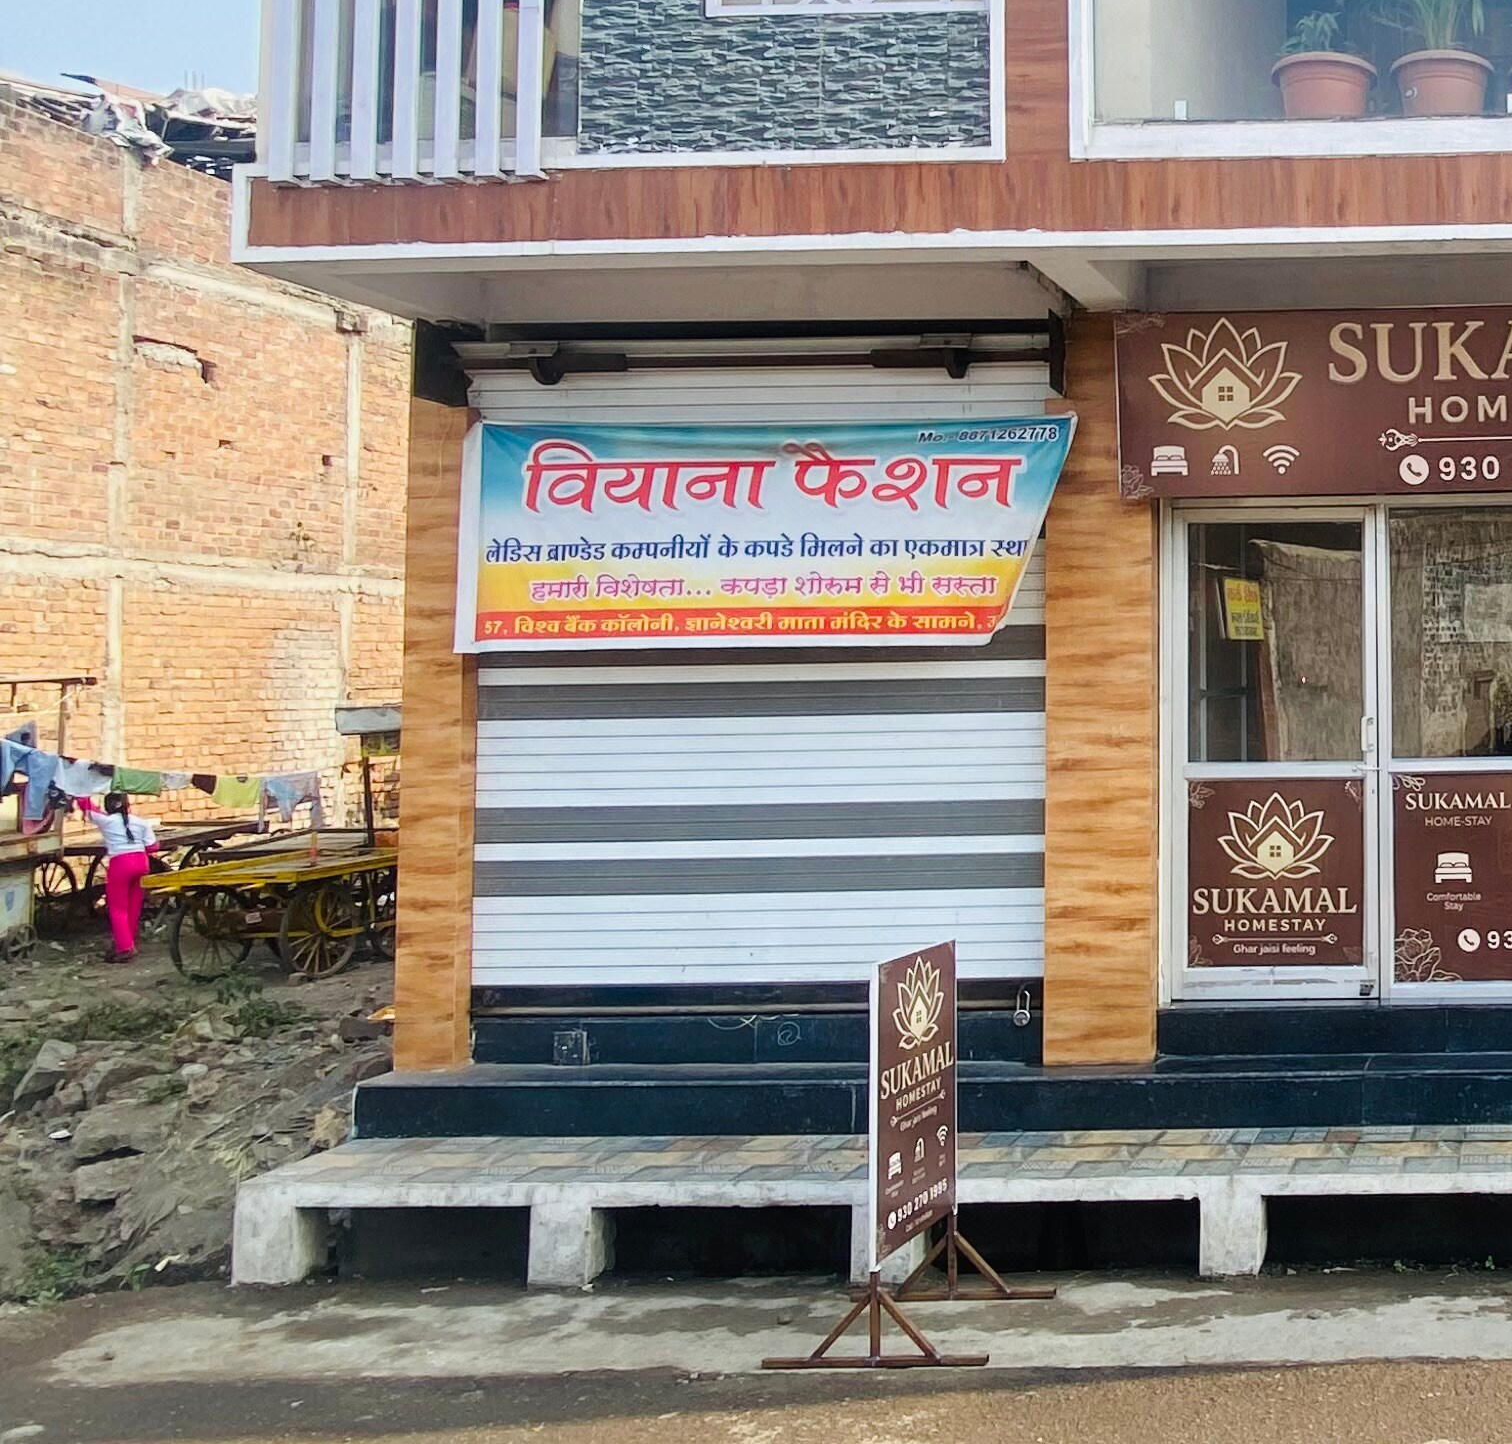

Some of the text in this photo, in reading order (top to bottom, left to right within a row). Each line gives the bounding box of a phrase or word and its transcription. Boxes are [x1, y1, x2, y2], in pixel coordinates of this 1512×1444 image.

[525, 440, 1023, 513] वियाना फैशन
[1438, 456, 1500, 481] 930
[485, 538, 542, 562] लेडिस
[611, 533, 711, 560] कम्पनीयों
[717, 533, 740, 558] के
[744, 532, 795, 558] कपडे
[800, 531, 864, 557] मिलने
[870, 539, 898, 557] का
[904, 539, 986, 560] एकमात्र
[990, 539, 1028, 558] स्था
[531, 574, 589, 601] हमारी
[720, 576, 788, 599] कपड़ा
[870, 570, 891, 595] से
[899, 571, 923, 595] भी
[931, 575, 997, 595] सस्ता
[514, 615, 560, 634] विश्व
[563, 613, 597, 633] बैंक
[685, 612, 773, 632] ज्ञानेश्वरी
[778, 616, 825, 631] माता
[829, 612, 883, 631] मंदिर
[887, 611, 908, 630] के
[1405, 792, 1512, 810] SUKAMAL
[1424, 816, 1492, 827] HOME-STAY
[1192, 887, 1358, 915] SUKAMAL
[1426, 892, 1481, 901] Comfortable
[1444, 901, 1464, 911] Stay
[1224, 918, 1327, 932] HOMESTAY
[1233, 944, 1316, 955] Ghar jaisi feeling
[881, 1041, 954, 1099] SUKAMAL
[896, 1076, 941, 1111] HOMESTAY
